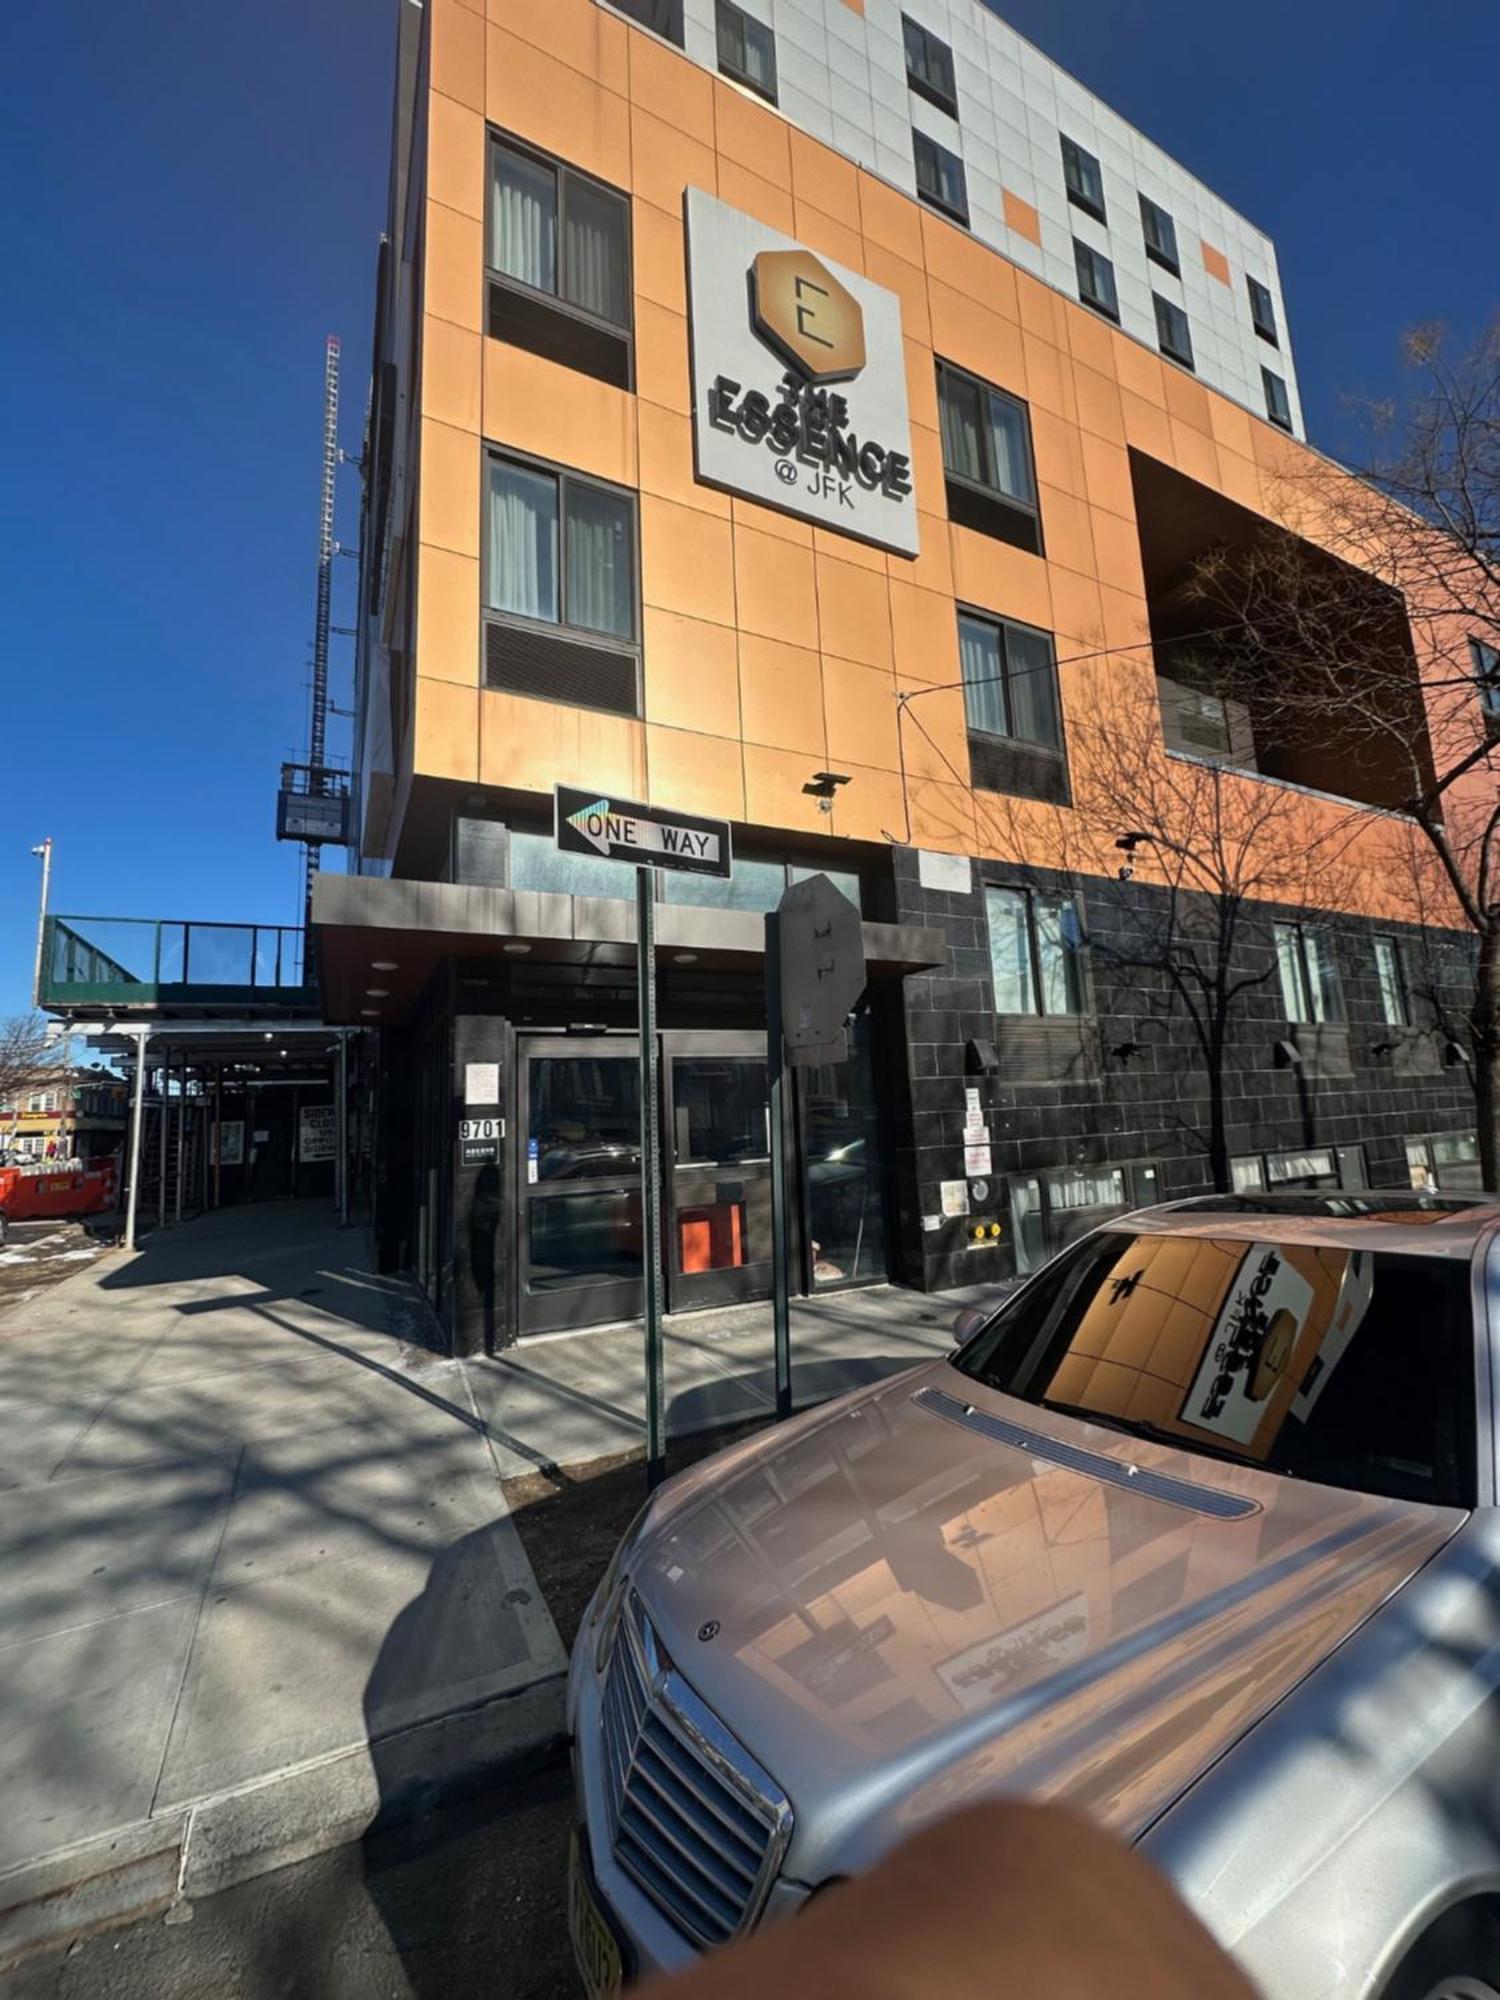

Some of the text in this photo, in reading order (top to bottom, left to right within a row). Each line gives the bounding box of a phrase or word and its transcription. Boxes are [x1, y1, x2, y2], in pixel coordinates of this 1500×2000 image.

[776, 372, 849, 430] THE
[708, 375, 912, 502] ESSENCE
[774, 458, 854, 509] @ JFK
[587, 813, 710, 856] ONE WAY
[461, 1120, 502, 1138] 9701
